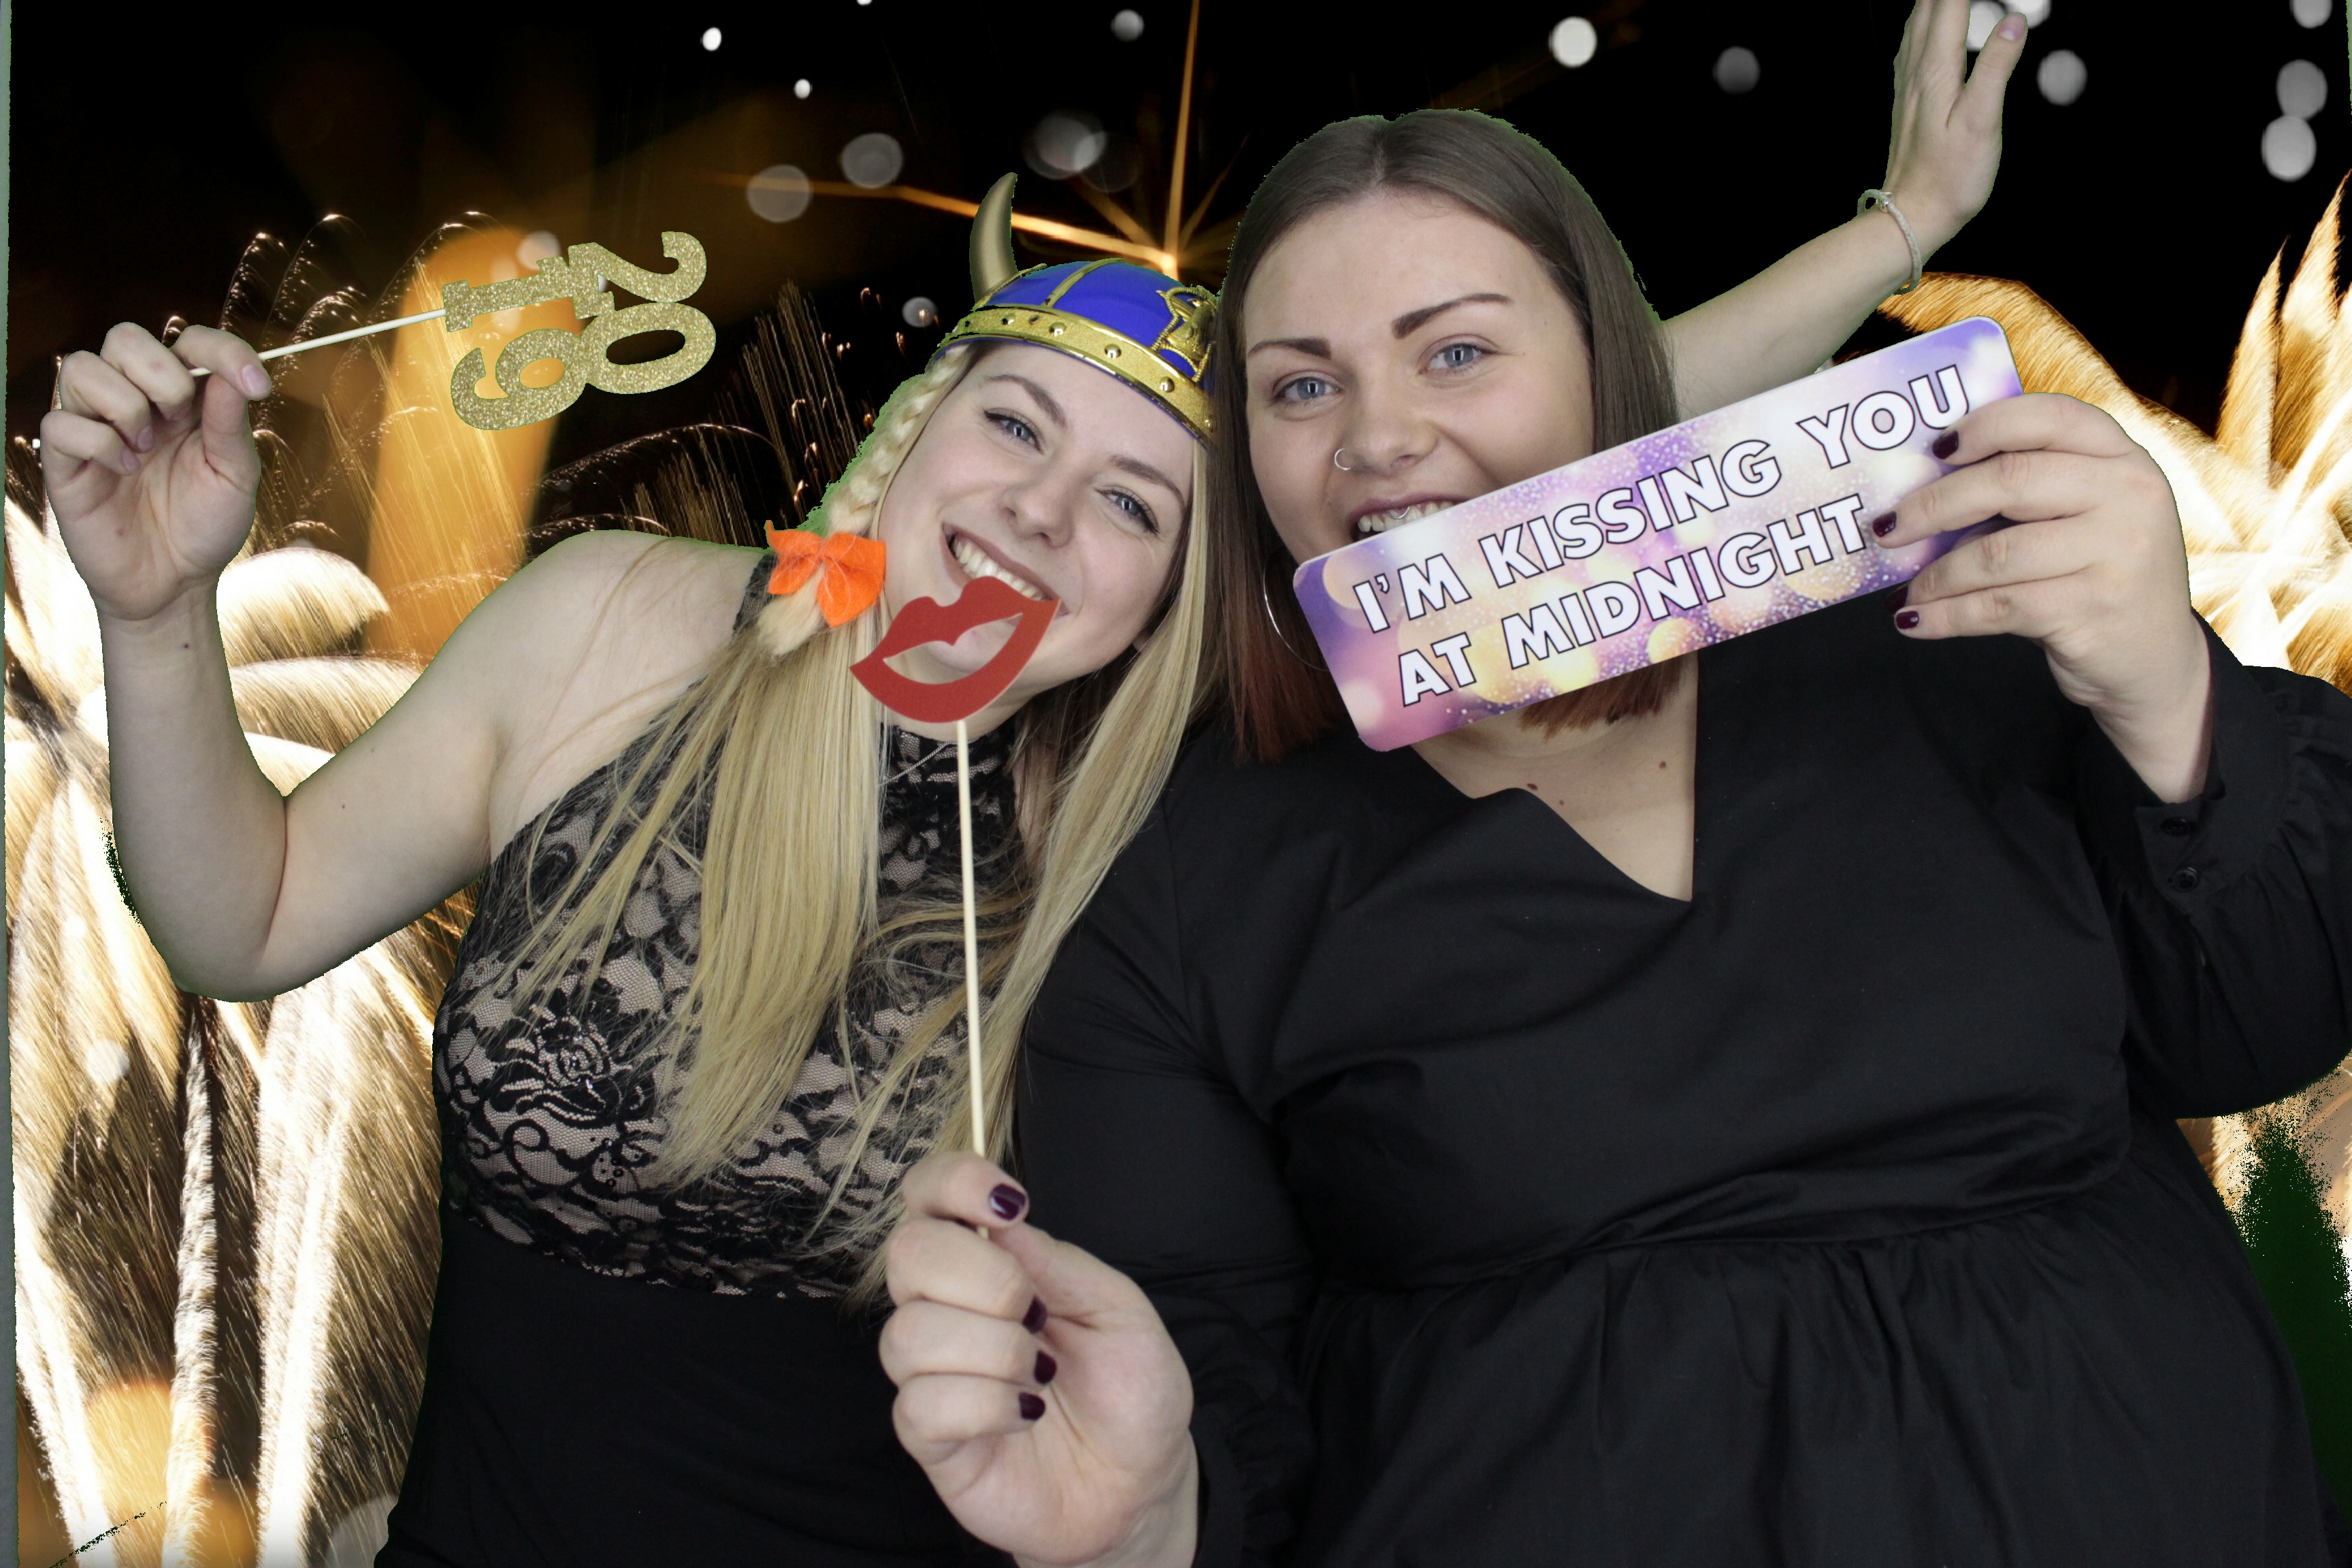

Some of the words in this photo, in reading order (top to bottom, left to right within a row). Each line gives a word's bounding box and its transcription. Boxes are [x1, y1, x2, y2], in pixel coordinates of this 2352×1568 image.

[1352, 553, 1472, 634] I'M
[1478, 439, 1782, 588] KISSING
[1797, 365, 1970, 470] YOU
[1399, 632, 1477, 707] AT
[1501, 493, 1867, 670] MIDNIGHT
